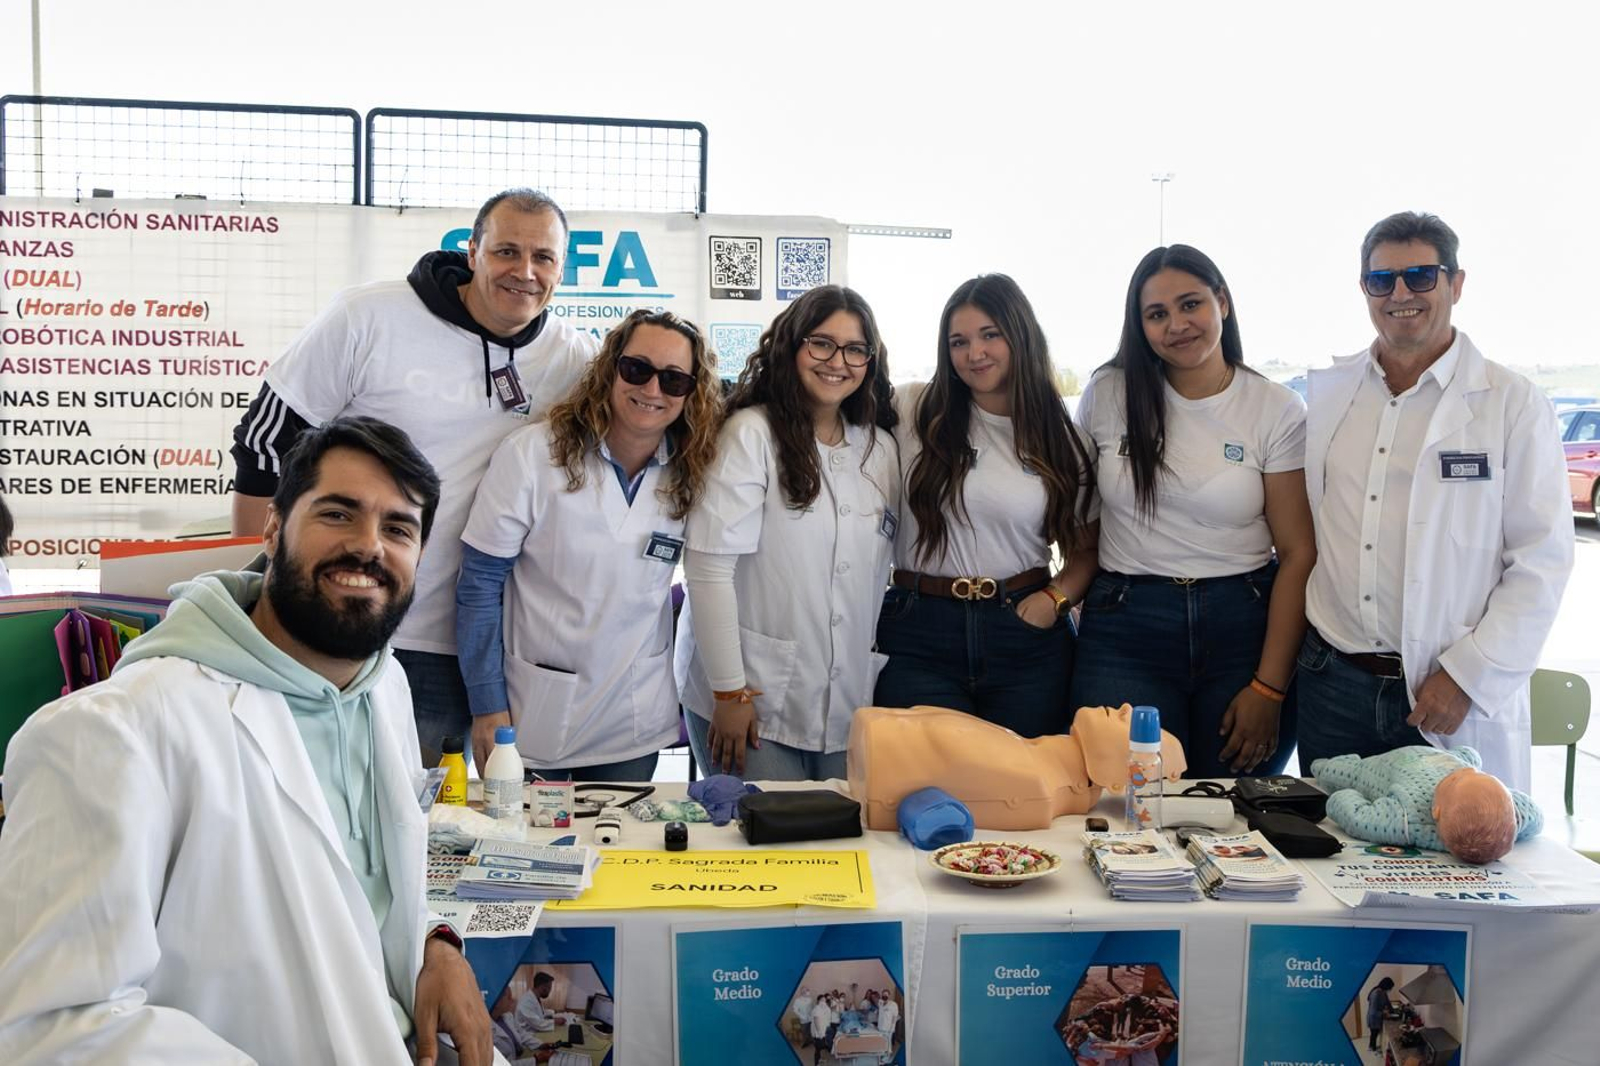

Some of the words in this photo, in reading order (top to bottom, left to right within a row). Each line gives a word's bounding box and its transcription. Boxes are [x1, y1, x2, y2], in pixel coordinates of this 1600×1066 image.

[146, 213, 279, 233] SANITARIAS
[4, 269, 82, 290] (DUAL)
[16, 298, 103, 319] (Horario
[110, 299, 136, 316] de
[144, 299, 209, 321] Tarde)
[0, 324, 106, 346] OBÓTICA
[112, 329, 244, 347] INDUSTRIAL
[1, 357, 150, 375] ASISTENCIAS
[0, 390, 50, 407] NAS
[57, 391, 86, 408] EN
[94, 387, 213, 408] SITUACIÓN
[221, 392, 249, 408] DE
[0, 419, 91, 437] TRATIVA
[0, 444, 145, 466] STAURACIÓN
[153, 448, 223, 469] (DUAL)
[61, 478, 91, 494] DE
[100, 474, 234, 494] ENFERMERÍA
[669, 858, 758, 867] Sagrada
[765, 858, 840, 866] Familia
[650, 883, 779, 892] SANIDAD
[1434, 891, 1520, 901] SAFA
[995, 964, 1040, 979] Grado
[1286, 957, 1331, 971] Grado
[712, 967, 759, 982] Grado
[1286, 975, 1333, 989] Medio
[714, 985, 762, 1001] Medio
[986, 982, 1052, 1000] Superior
